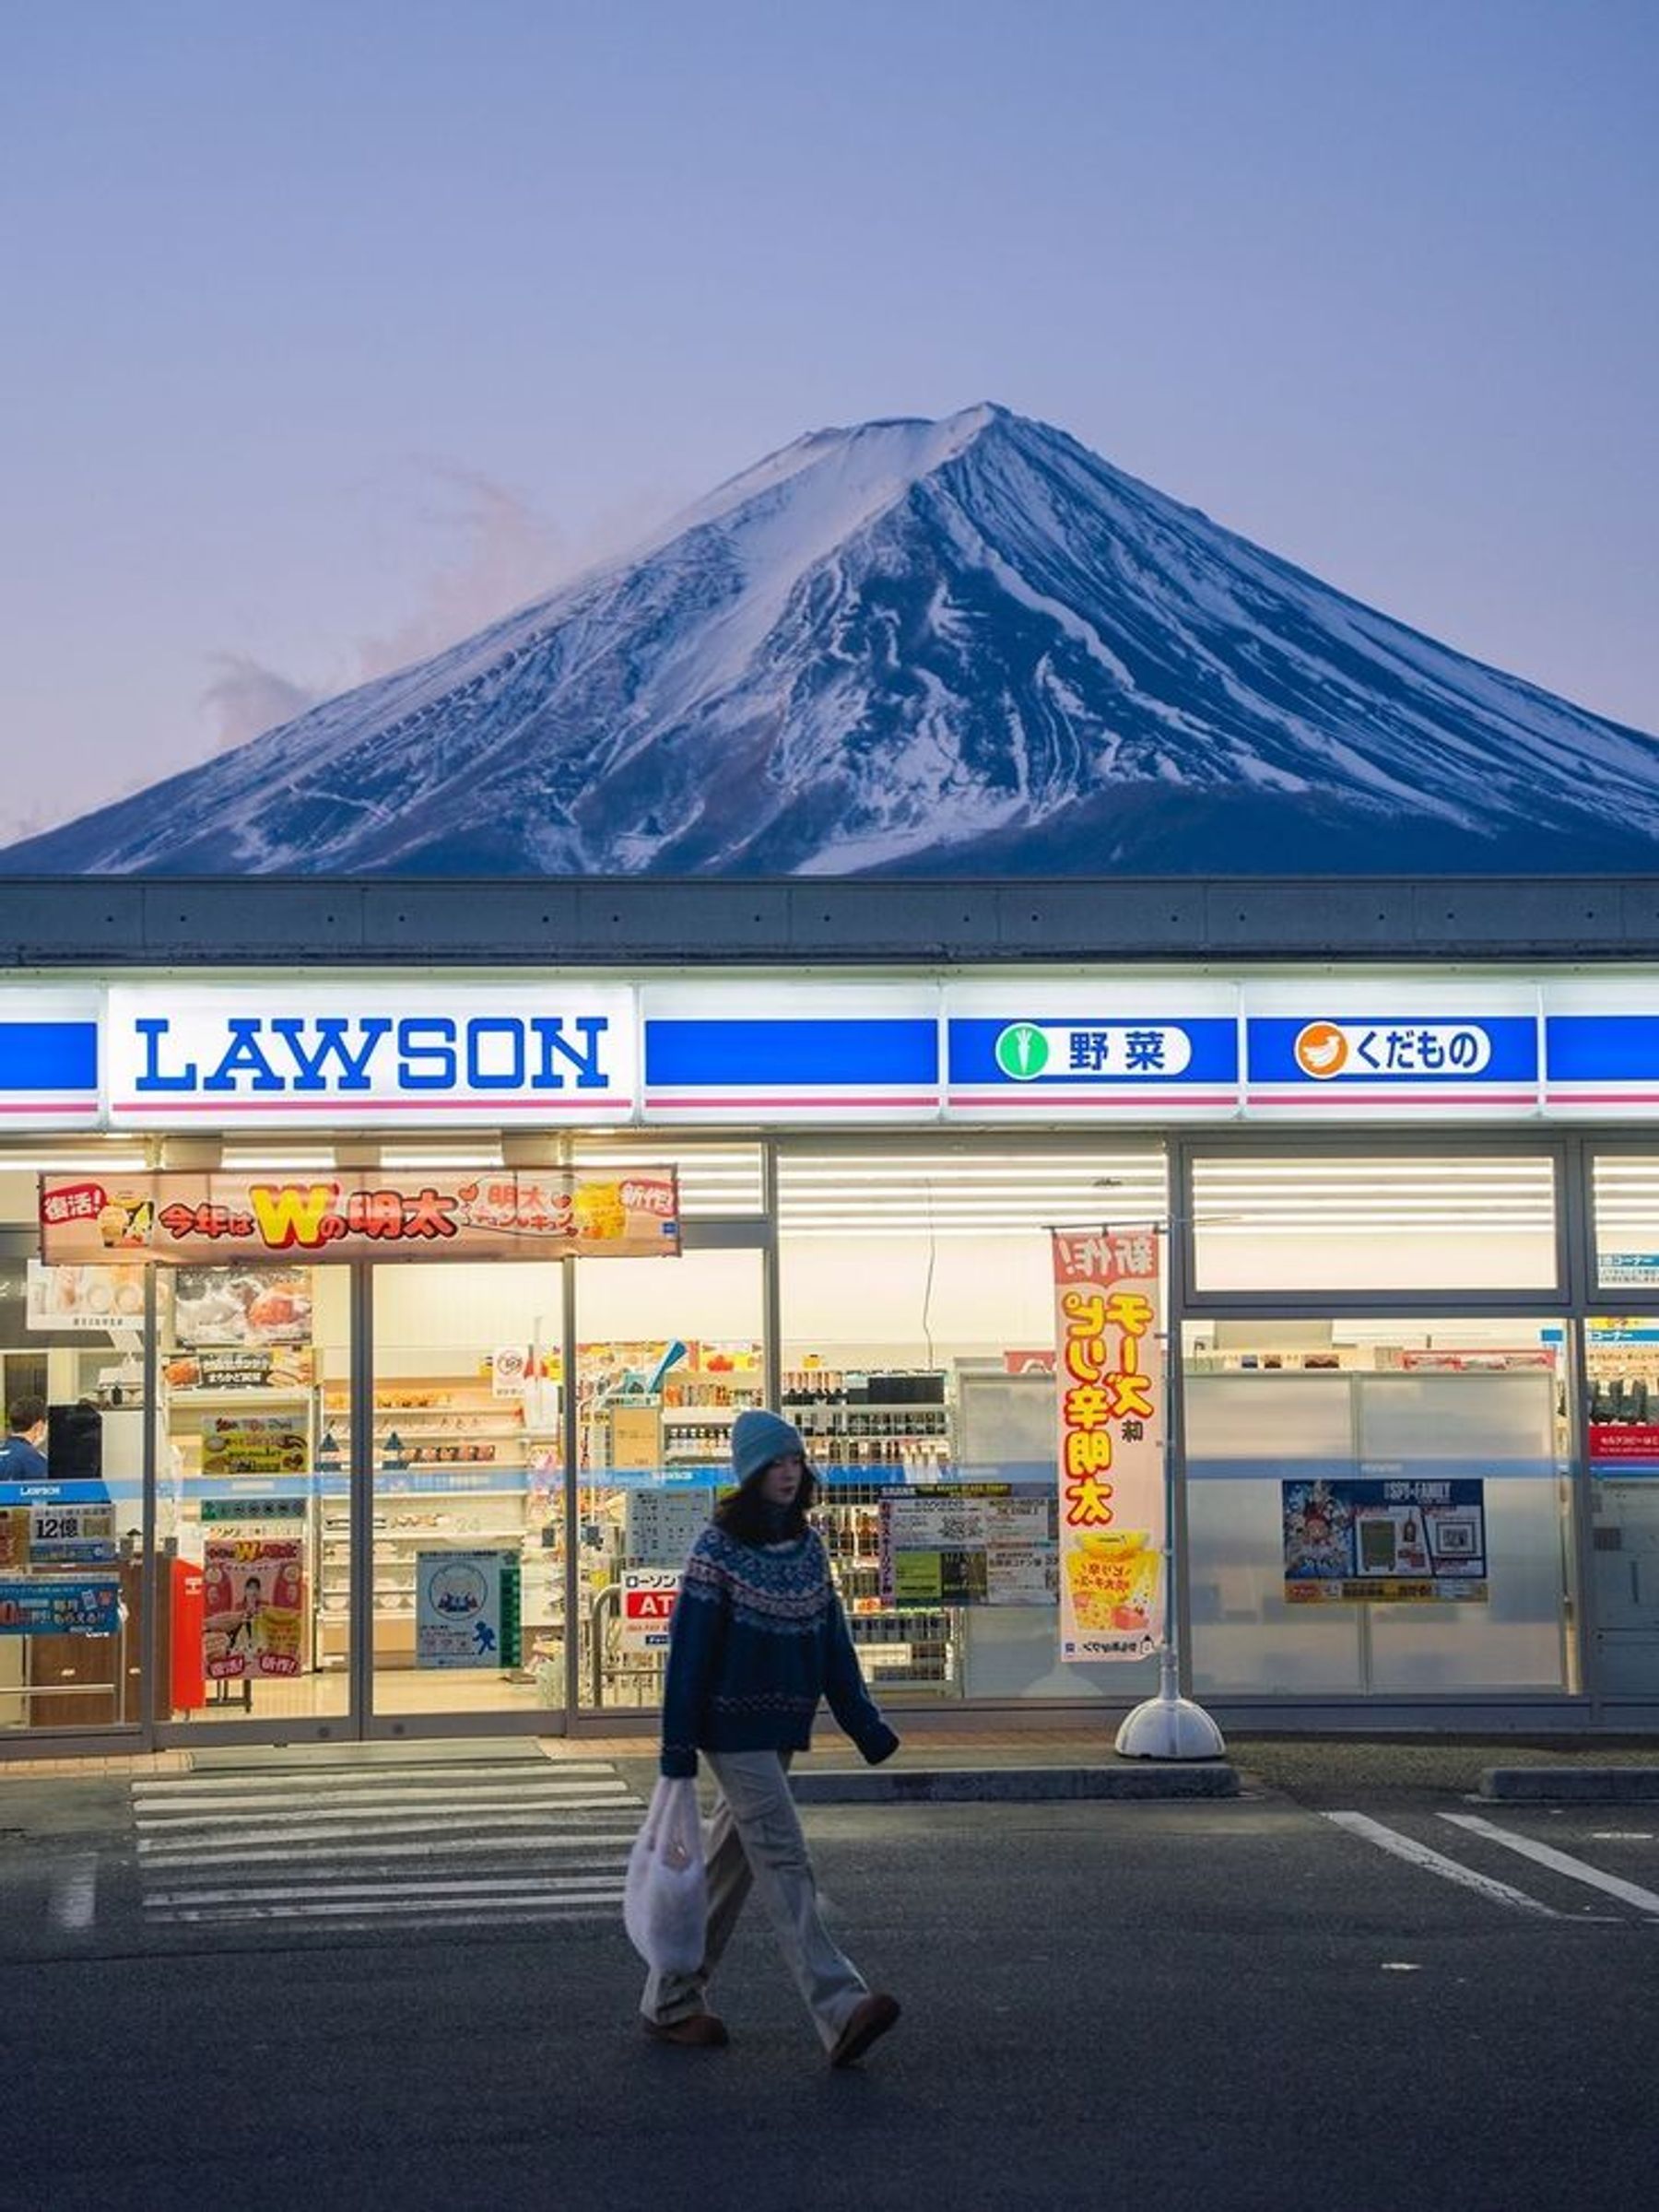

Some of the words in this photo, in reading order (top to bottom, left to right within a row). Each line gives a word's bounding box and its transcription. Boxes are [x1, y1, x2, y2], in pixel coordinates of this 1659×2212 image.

[135, 1016, 609, 1092] LAWSON
[1068, 1030, 1166, 1072] 野菜
[1357, 1030, 1478, 1070] くだもの
[625, 1574, 683, 1589] ローソン
[638, 1594, 676, 1616] AT
